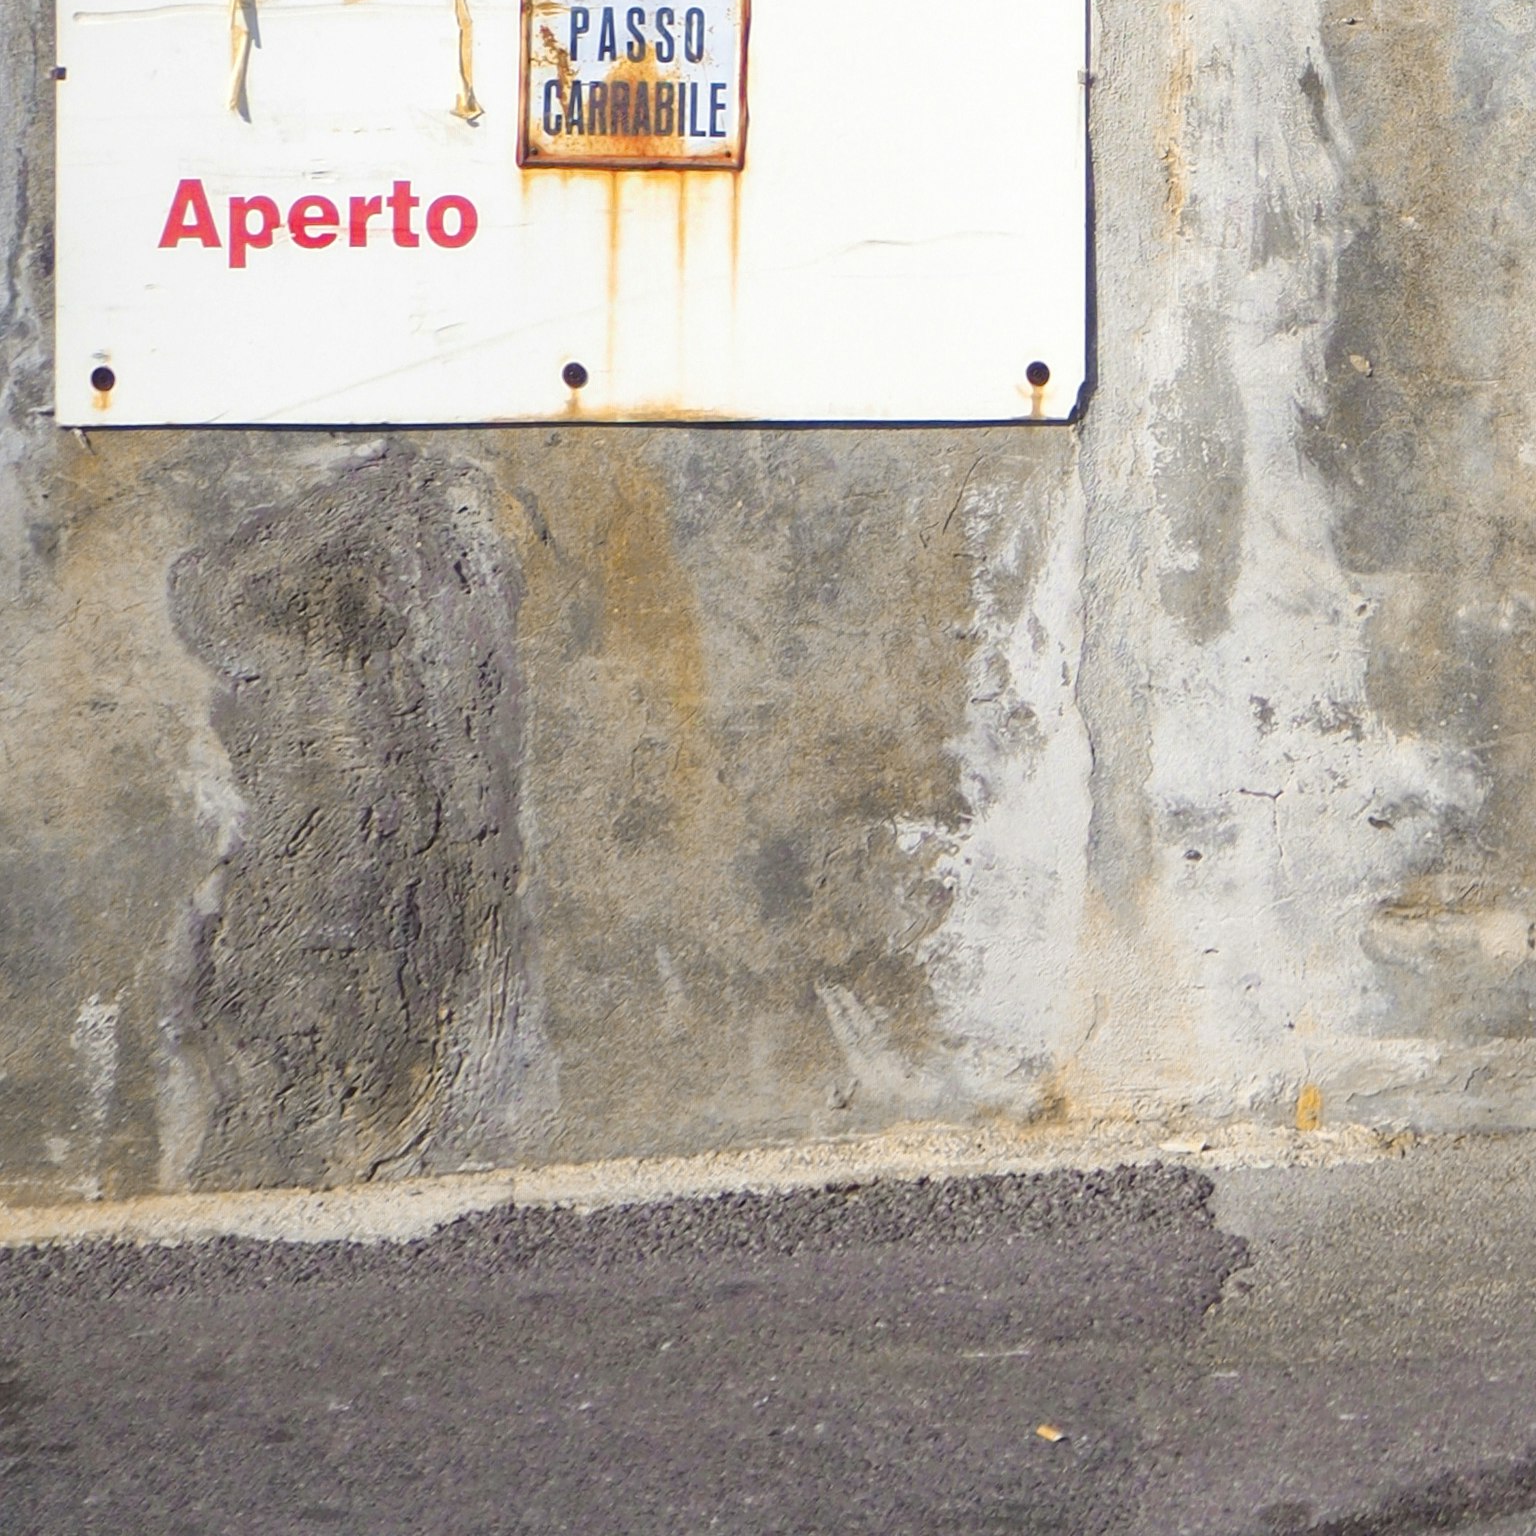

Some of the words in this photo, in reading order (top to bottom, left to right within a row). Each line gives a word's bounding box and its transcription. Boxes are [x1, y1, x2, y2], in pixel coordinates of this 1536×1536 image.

[569, 6, 706, 65] PASSO
[541, 78, 728, 139] CARRABILE
[157, 178, 479, 269] Aperto
